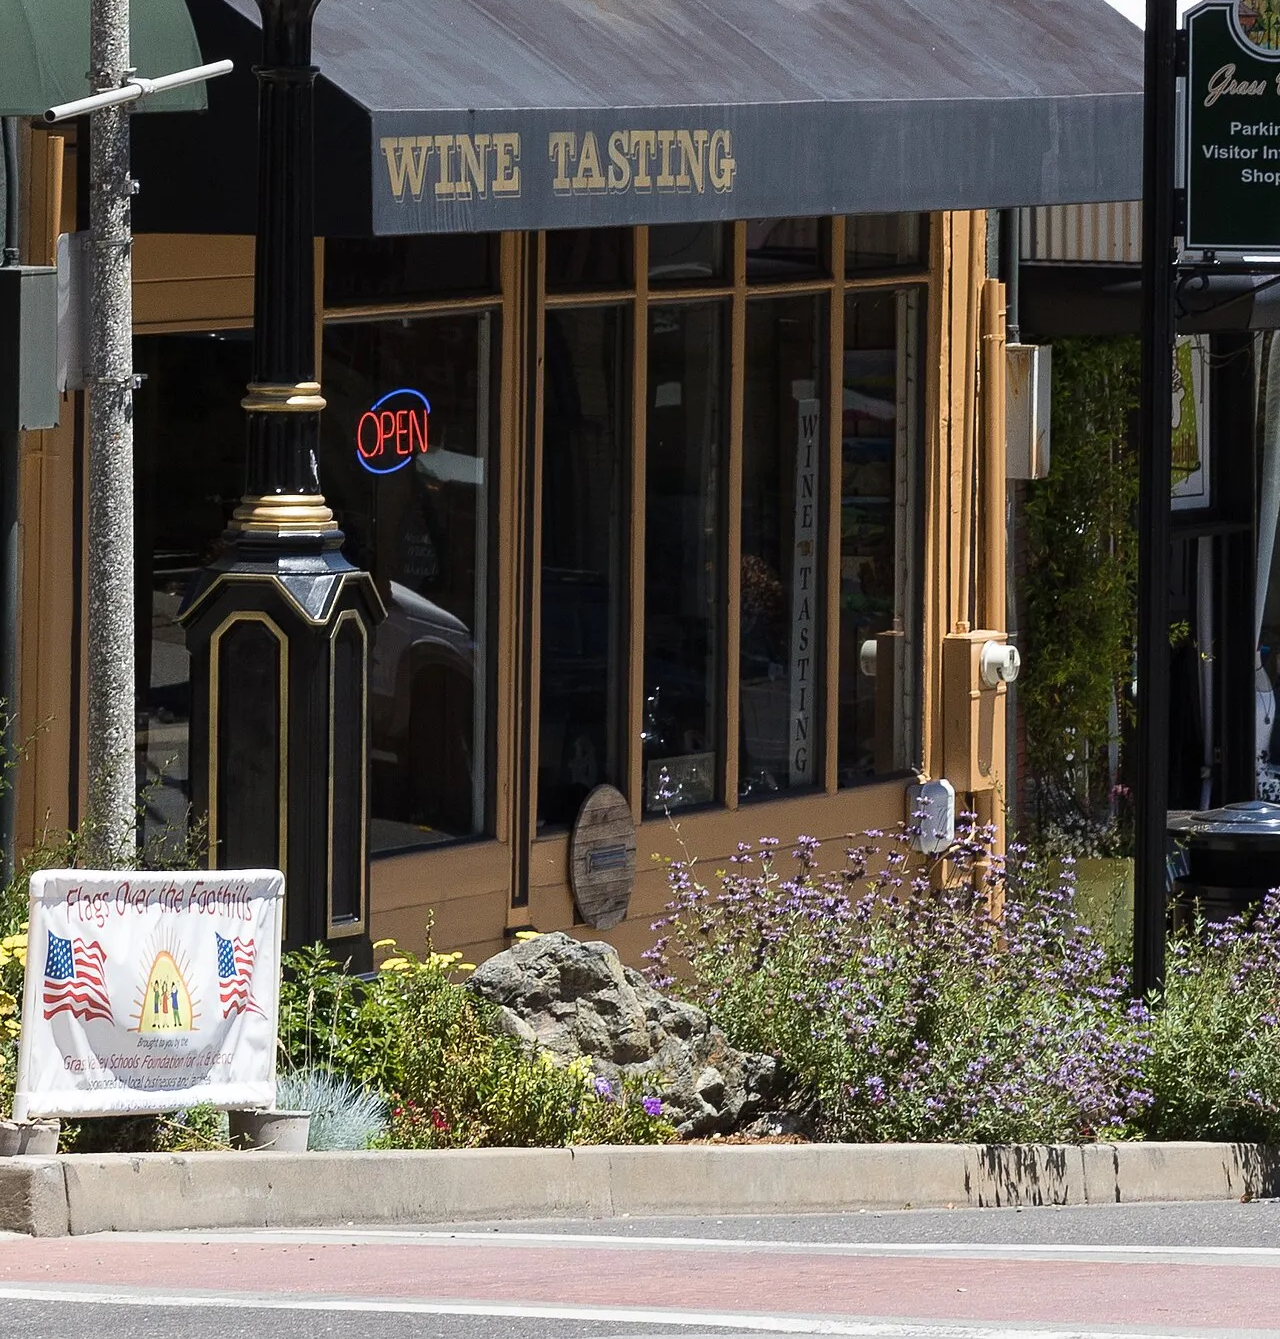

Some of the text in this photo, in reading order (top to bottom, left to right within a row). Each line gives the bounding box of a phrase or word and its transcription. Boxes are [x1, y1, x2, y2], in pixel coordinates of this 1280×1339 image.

[1203, 63, 1266, 108] Grass
[379, 129, 738, 203] WINE TASTING
[1202, 144, 1258, 160] Visitor
[356, 409, 430, 459] OPEN
[794, 414, 818, 773] WINE TASTING
[66, 880, 253, 928] Flags Over the Foothills
[109, 1052, 140, 1069] Schools
[141, 1054, 186, 1070] Foundation
